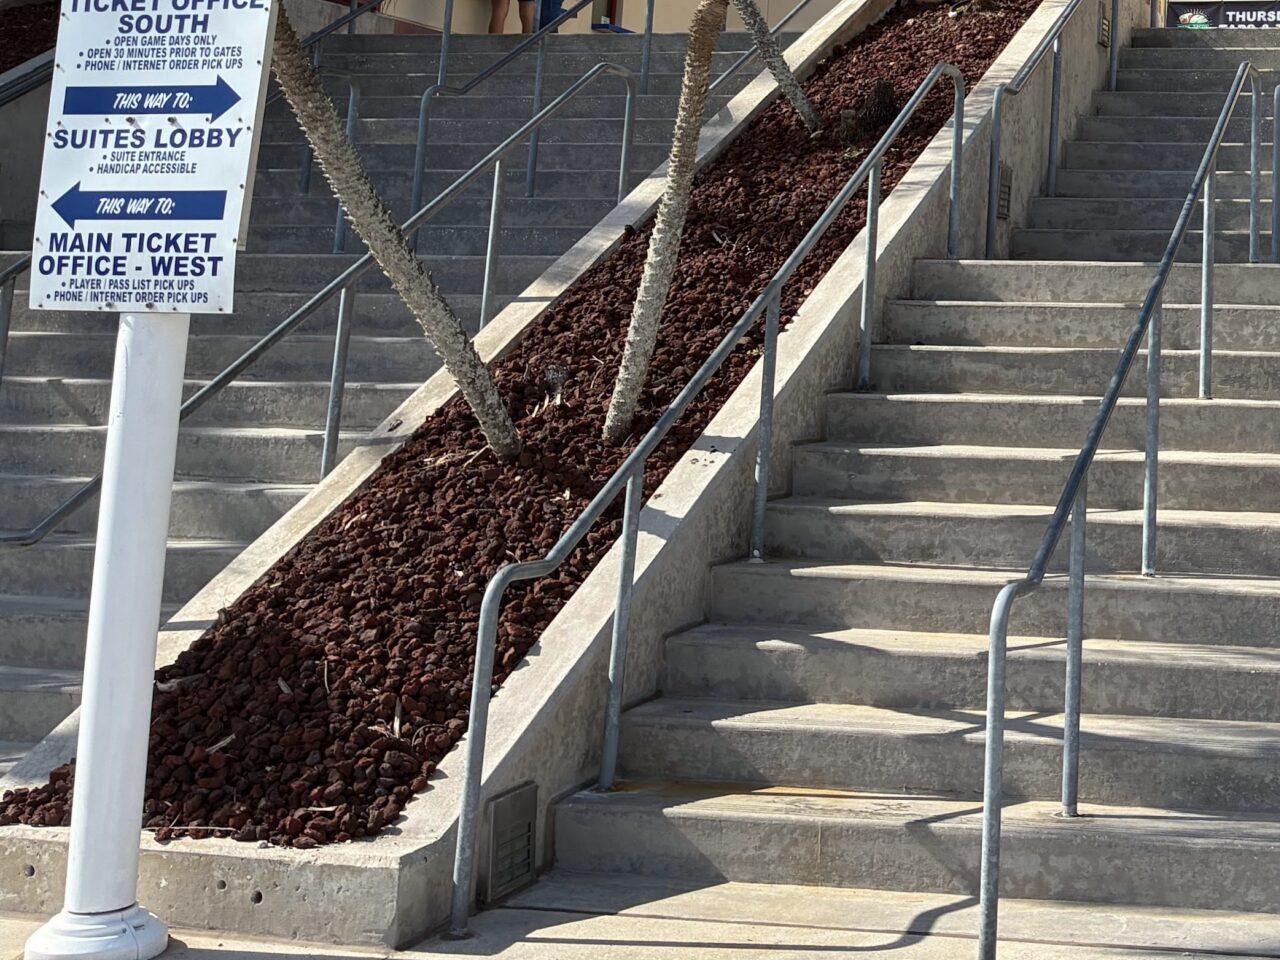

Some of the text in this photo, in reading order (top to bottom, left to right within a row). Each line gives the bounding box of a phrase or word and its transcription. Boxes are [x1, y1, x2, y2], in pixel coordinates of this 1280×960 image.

[118, 14, 210, 34] SOUTH
[114, 35, 217, 47] OPEN GAME DAYS ONLY
[87, 47, 242, 58] OPEN 30 MINUTES PRIOR TO GATES
[85, 60, 115, 71] PHONE
[122, 60, 167, 70] INTERNET
[169, 59, 200, 70] ORDER
[201, 59, 224, 69] PICK
[225, 58, 243, 69] UPS
[113, 92, 193, 109] THIS WAY TO:
[53, 128, 243, 149] SUITES LOBBY
[110, 151, 186, 162] SUITE ENTRANCE
[97, 163, 197, 174] HANDICAP ACCESSIBLE
[96, 198, 176, 214] THIS WAY TO:
[49, 233, 217, 253] MAIN TICKET
[38, 256, 127, 276] OFFICE
[151, 256, 224, 277] WEST
[70, 279, 102, 289] PLAYER
[109, 279, 130, 290] PASS
[132, 279, 152, 290] LIST
[153, 279, 175, 290] PICK
[177, 280, 194, 290] UPS
[54, 291, 84, 302] PHONE
[90, 291, 133, 302] INTERNET
[135, 292, 165, 303] ORDER
[166, 292, 188, 303] PICK
[190, 292, 208, 303] UPS
